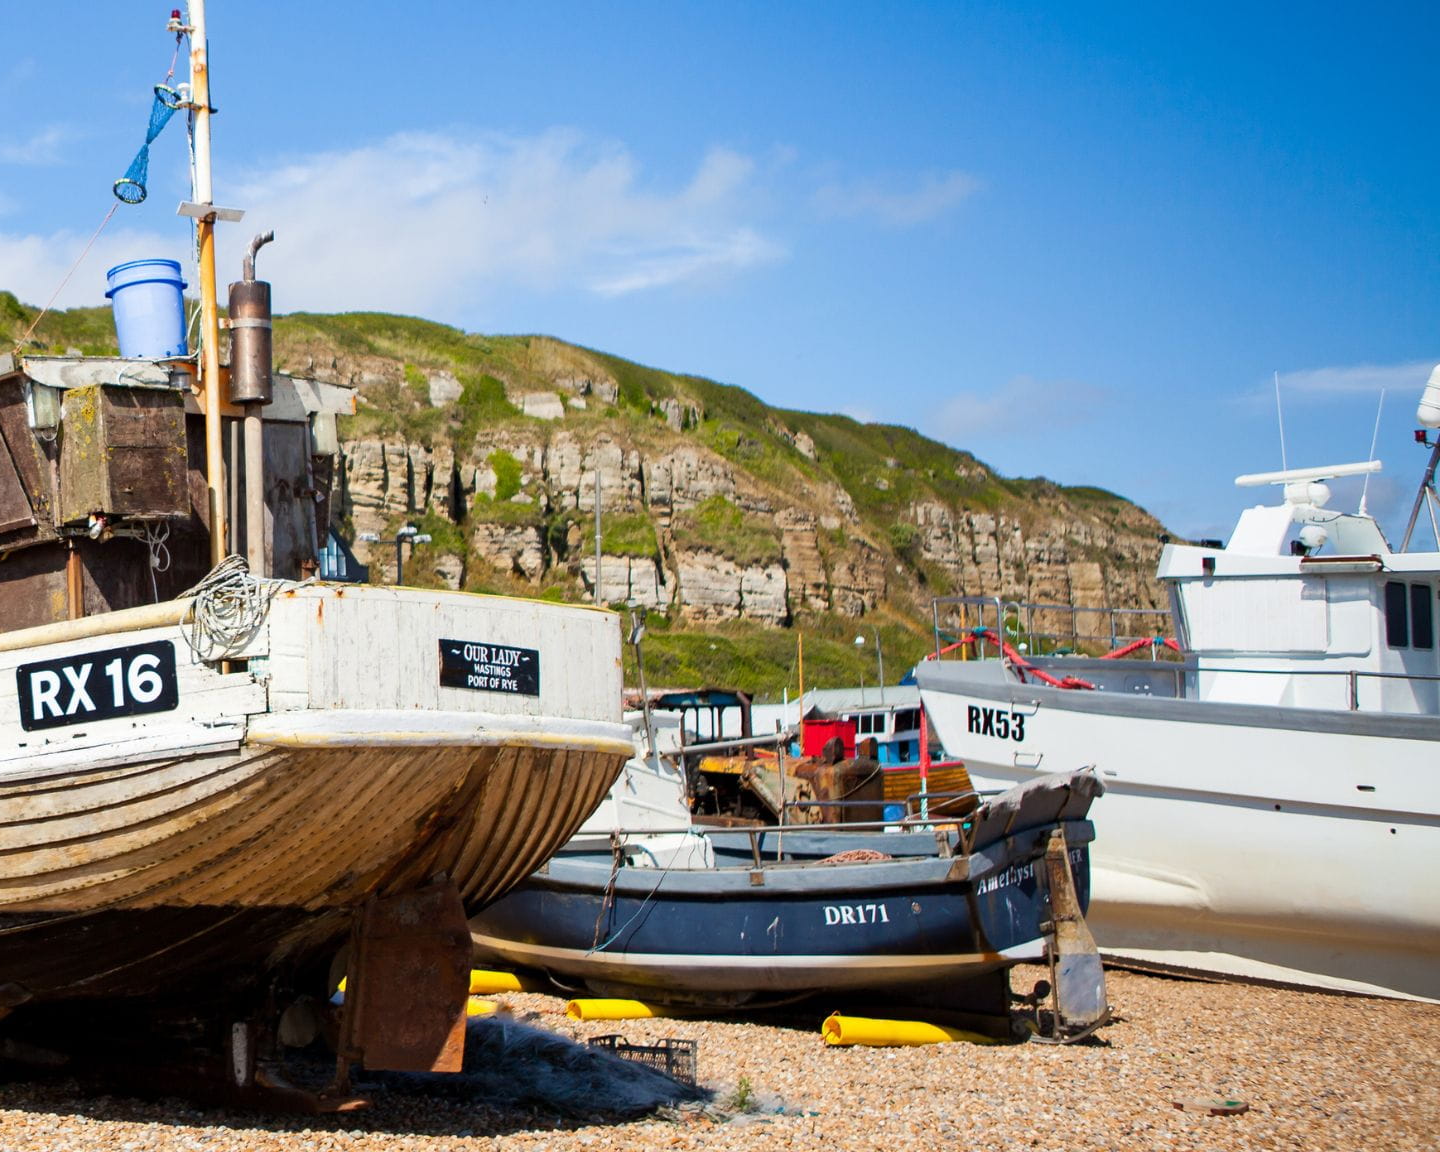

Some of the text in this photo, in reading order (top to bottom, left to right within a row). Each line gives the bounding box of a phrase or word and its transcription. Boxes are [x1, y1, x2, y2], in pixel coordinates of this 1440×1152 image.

[463, 643, 522, 667] OUR LADY
[473, 663, 512, 678] HASTINGS
[30, 653, 164, 721] RX 16
[467, 675, 519, 691] PORT OF RYE
[967, 704, 1025, 742] RX53
[976, 863, 1035, 896] Amethyst
[823, 903, 891, 926] DR171
